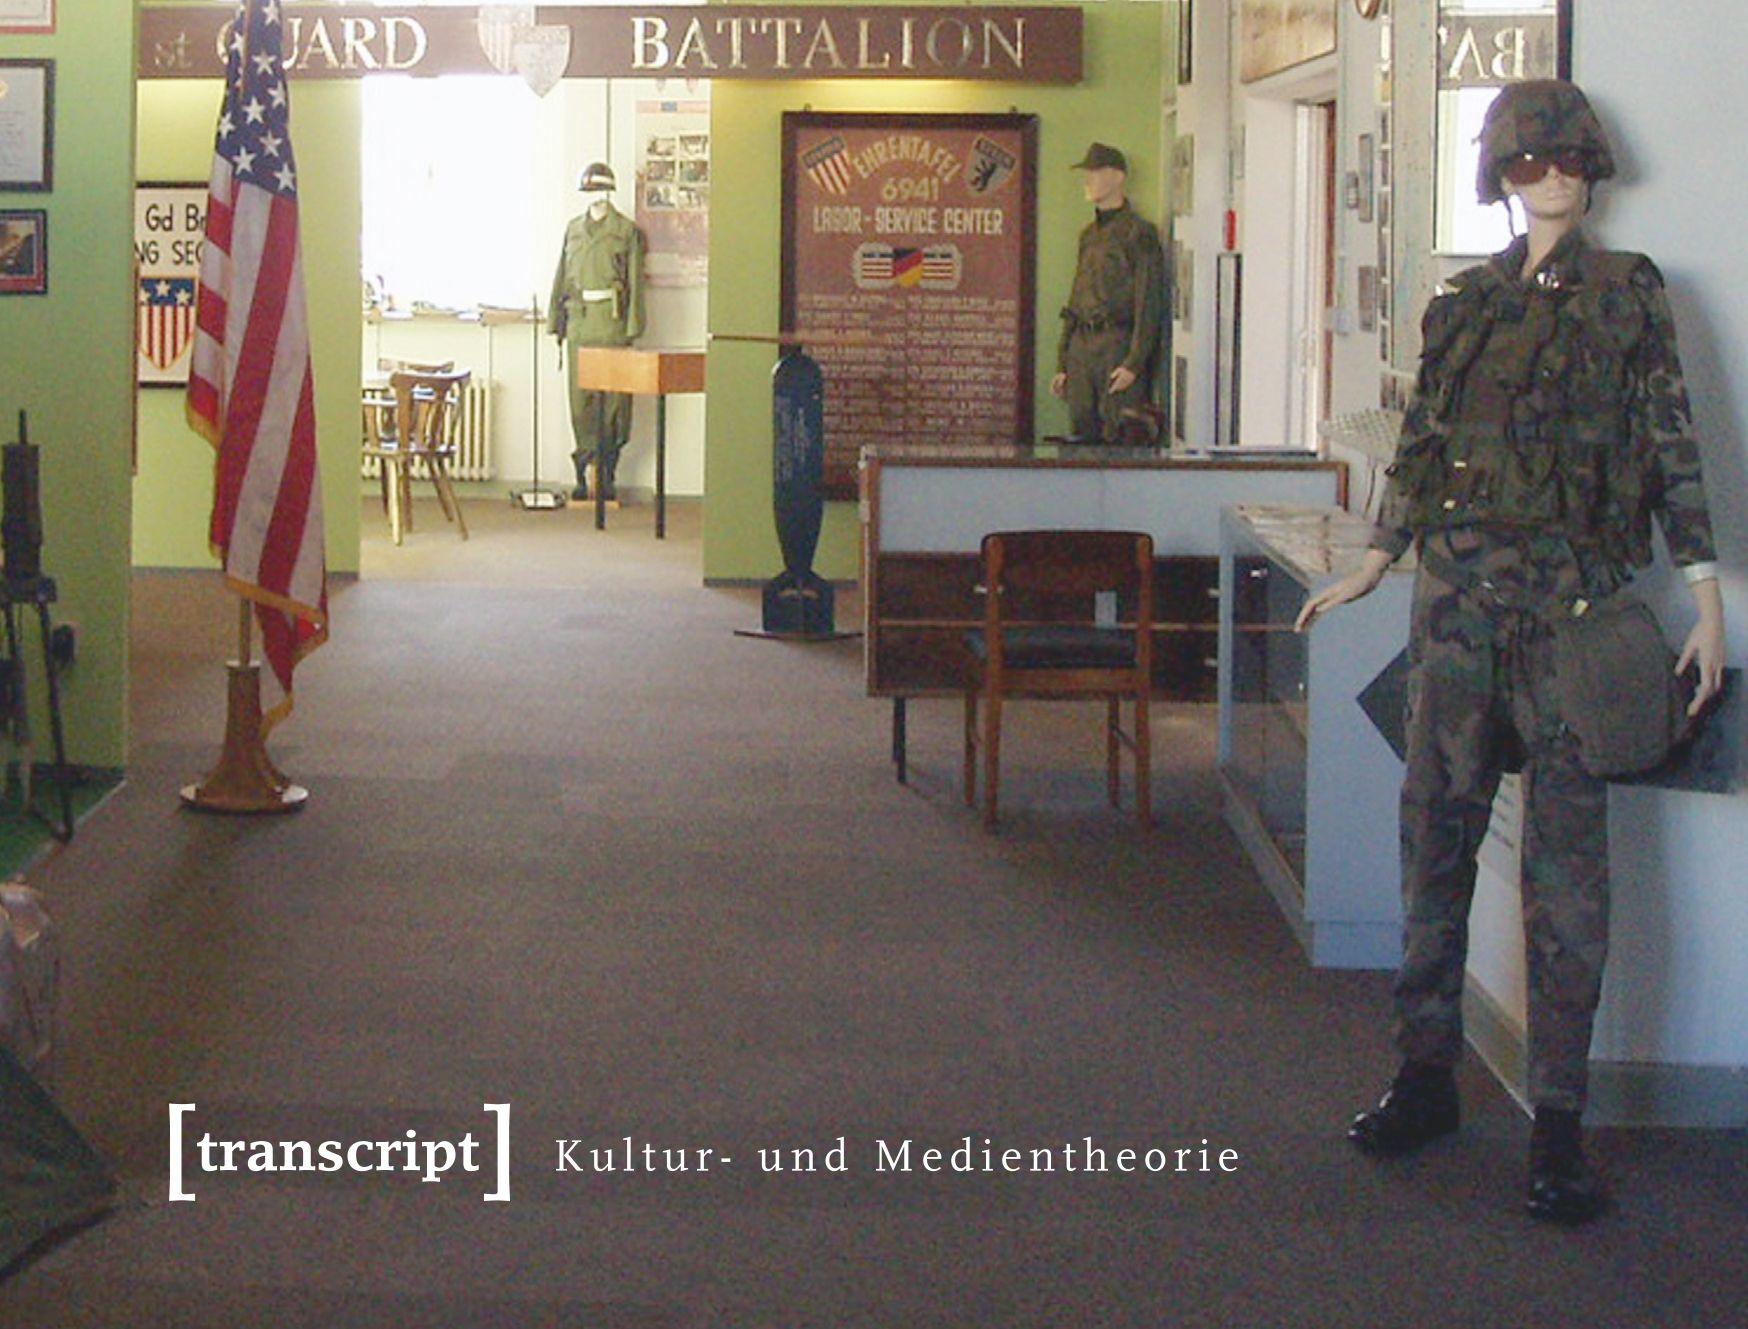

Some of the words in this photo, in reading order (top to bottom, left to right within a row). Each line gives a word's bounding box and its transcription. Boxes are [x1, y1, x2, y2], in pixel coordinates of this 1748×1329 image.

[631, 16, 1026, 70] BATTALION
[852, 135, 963, 183] EHRENTAFEL
[881, 177, 940, 202] 6941
[146, 203, 174, 232] Gd
[944, 206, 1004, 235] CENTER
